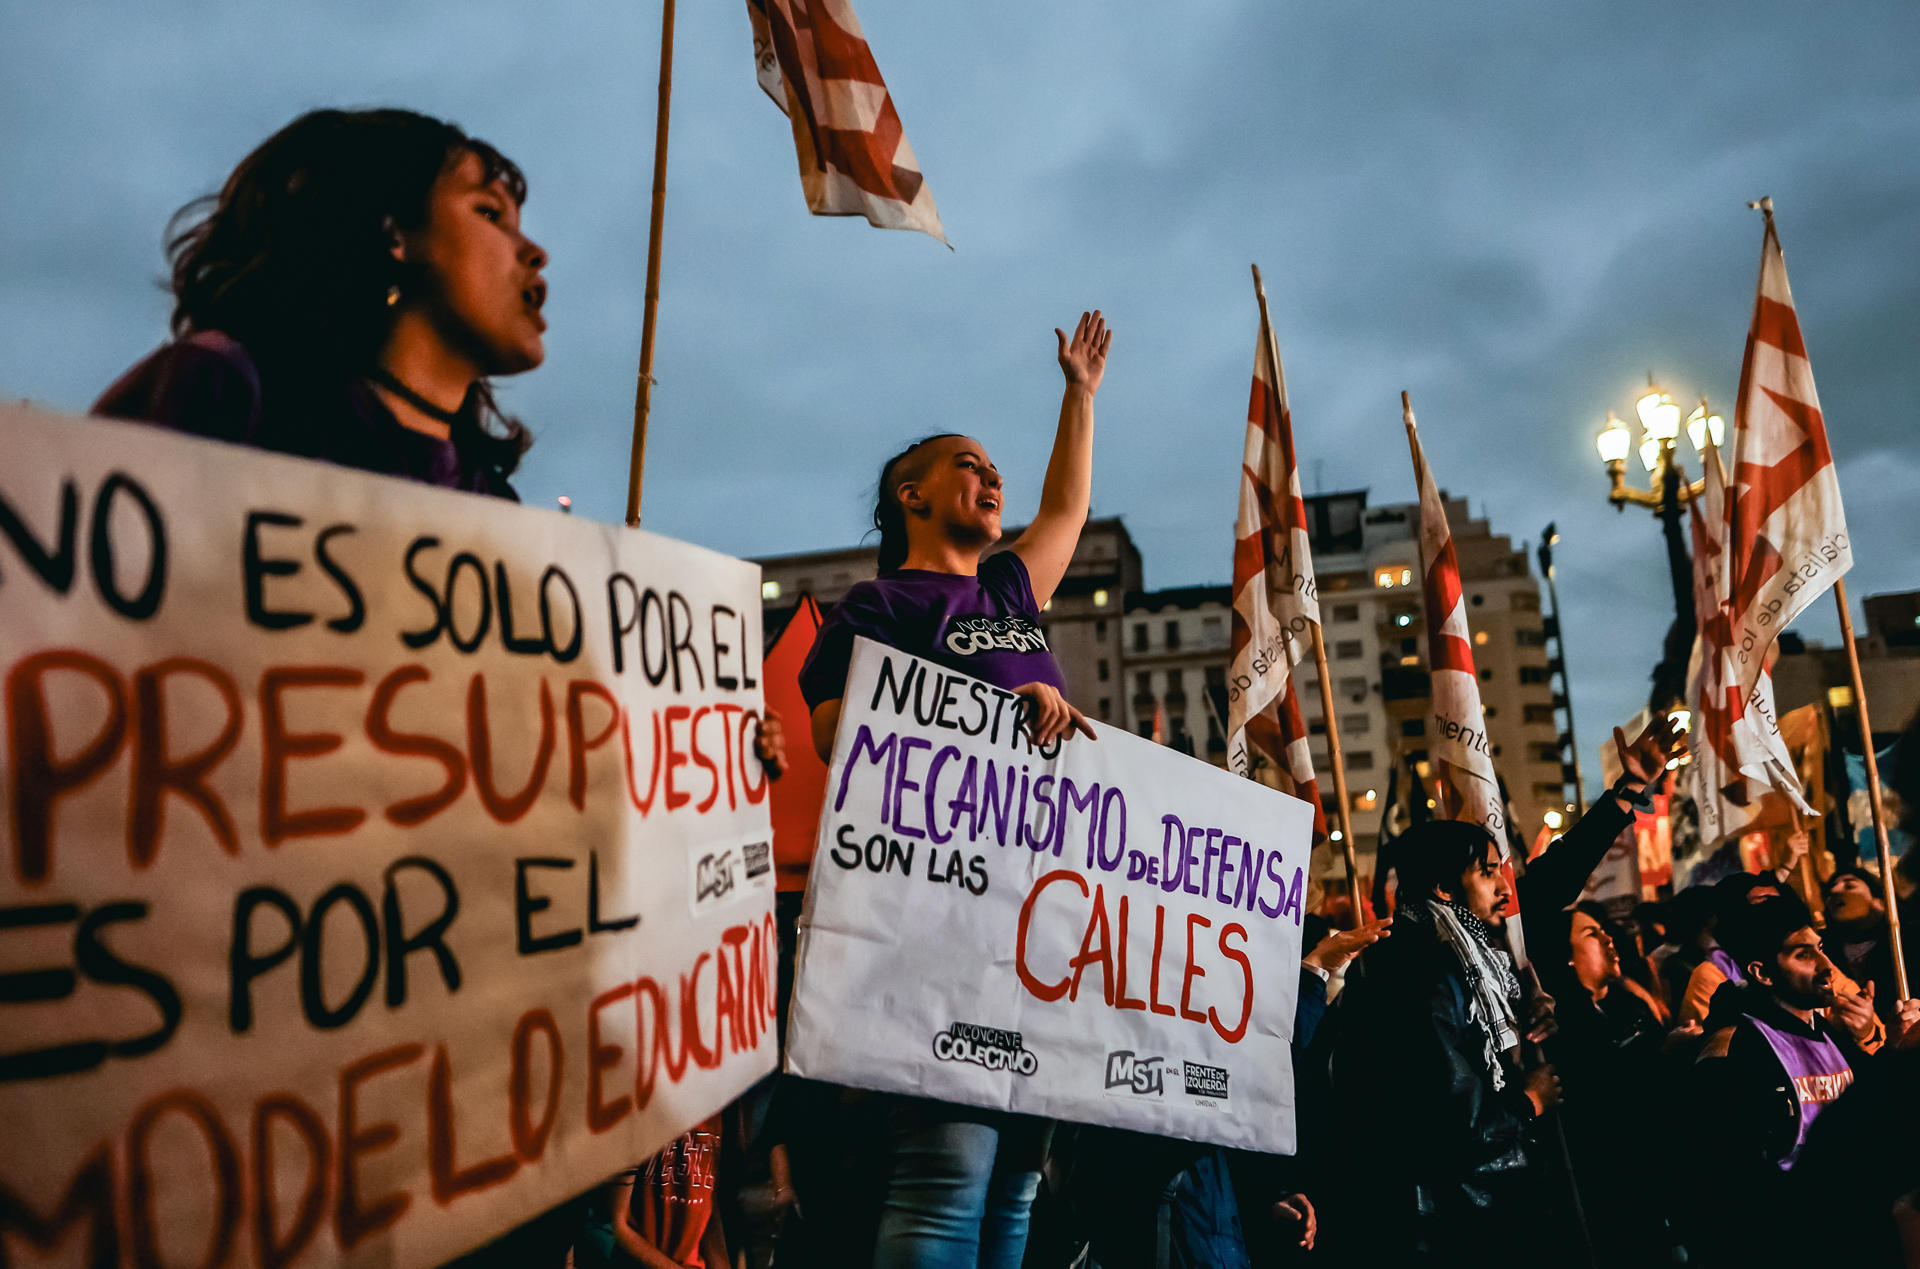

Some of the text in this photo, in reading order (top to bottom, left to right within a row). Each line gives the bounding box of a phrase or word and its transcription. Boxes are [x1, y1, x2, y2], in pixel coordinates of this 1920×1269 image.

[0, 470, 757, 694] NO ES SOLO POR EL
[946, 628, 1050, 655] COLECTIV
[5, 648, 768, 886] PRESUPUESTO
[835, 825, 988, 895] SON LAS
[1161, 814, 1303, 926] DEFENSA
[230, 855, 461, 1035] POR
[516, 851, 641, 955] EL
[1016, 869, 1254, 1044] CALLES
[934, 1032, 1037, 1075] COLECTIVO
[1105, 1051, 1164, 1094] MST
[1185, 1064, 1216, 1080] FRENTE
[1185, 1075, 1227, 1092] IZQUIERDA
